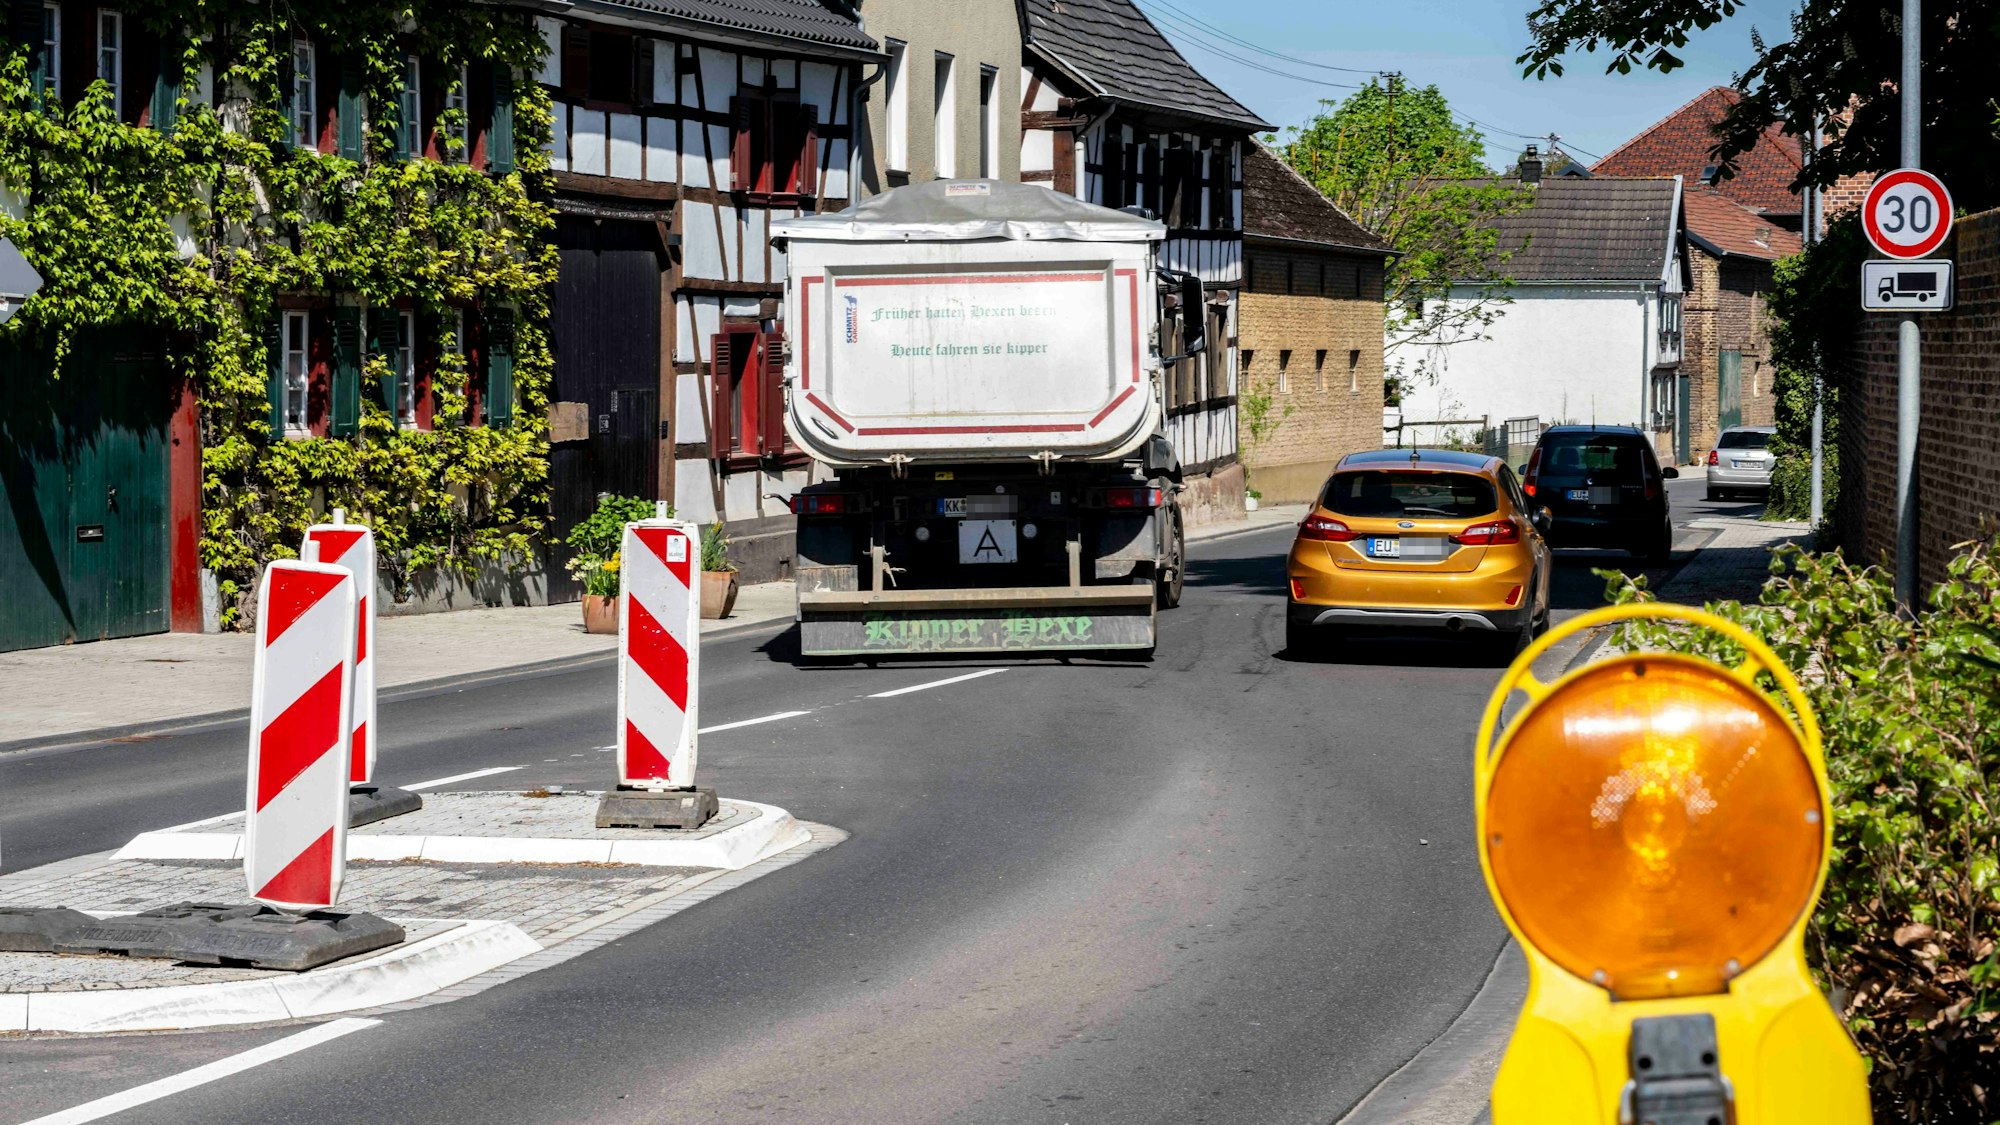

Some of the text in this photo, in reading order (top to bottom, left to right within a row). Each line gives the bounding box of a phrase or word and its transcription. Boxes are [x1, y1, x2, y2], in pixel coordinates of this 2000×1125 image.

[1883, 195, 1932, 234] 30
[870, 307, 921, 322] Früher
[925, 306, 965, 322] hatten
[890, 341, 1048, 358] Heute fahren sie kipper
[945, 500, 960, 513] KK
[973, 525, 1003, 557] A
[1376, 540, 1392, 552] EU
[864, 608, 1094, 650] Kipper Hexe
